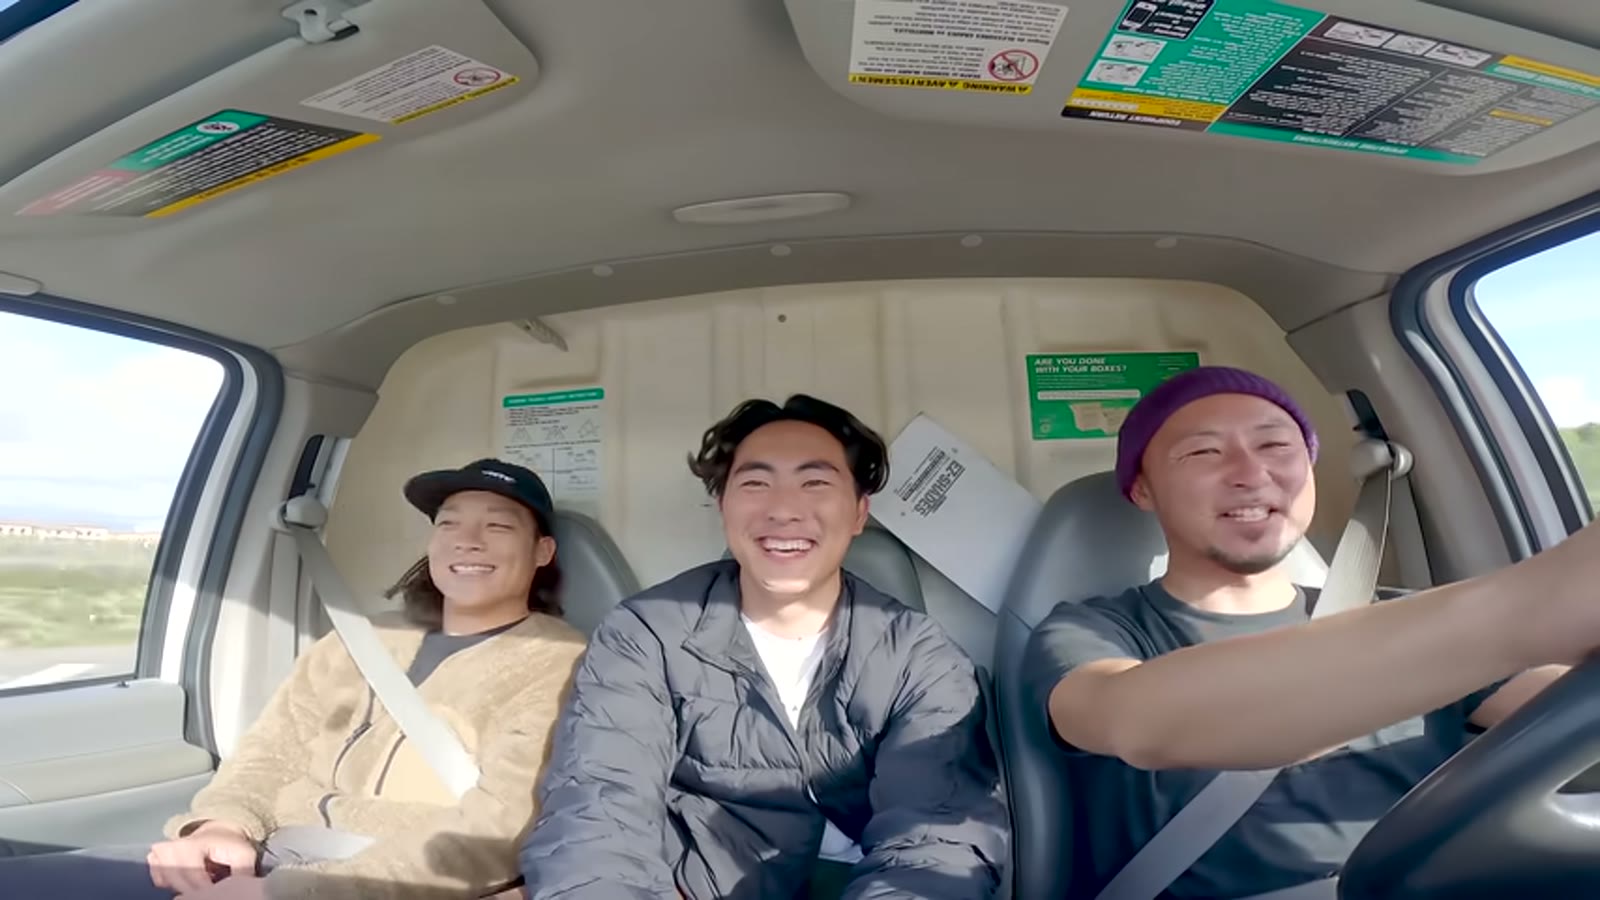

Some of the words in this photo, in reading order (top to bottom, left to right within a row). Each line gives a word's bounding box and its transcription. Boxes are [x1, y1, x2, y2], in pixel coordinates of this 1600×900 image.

[962, 82, 1016, 93] WARNING
[1034, 358, 1053, 366] ARE
[1056, 358, 1077, 366] YOU
[1078, 357, 1106, 365] DONE
[1035, 366, 1060, 374] WITH
[1062, 365, 1088, 373] YOUR
[1090, 364, 1127, 373] BOXES?
[914, 460, 963, 516] EZ-SHADES
